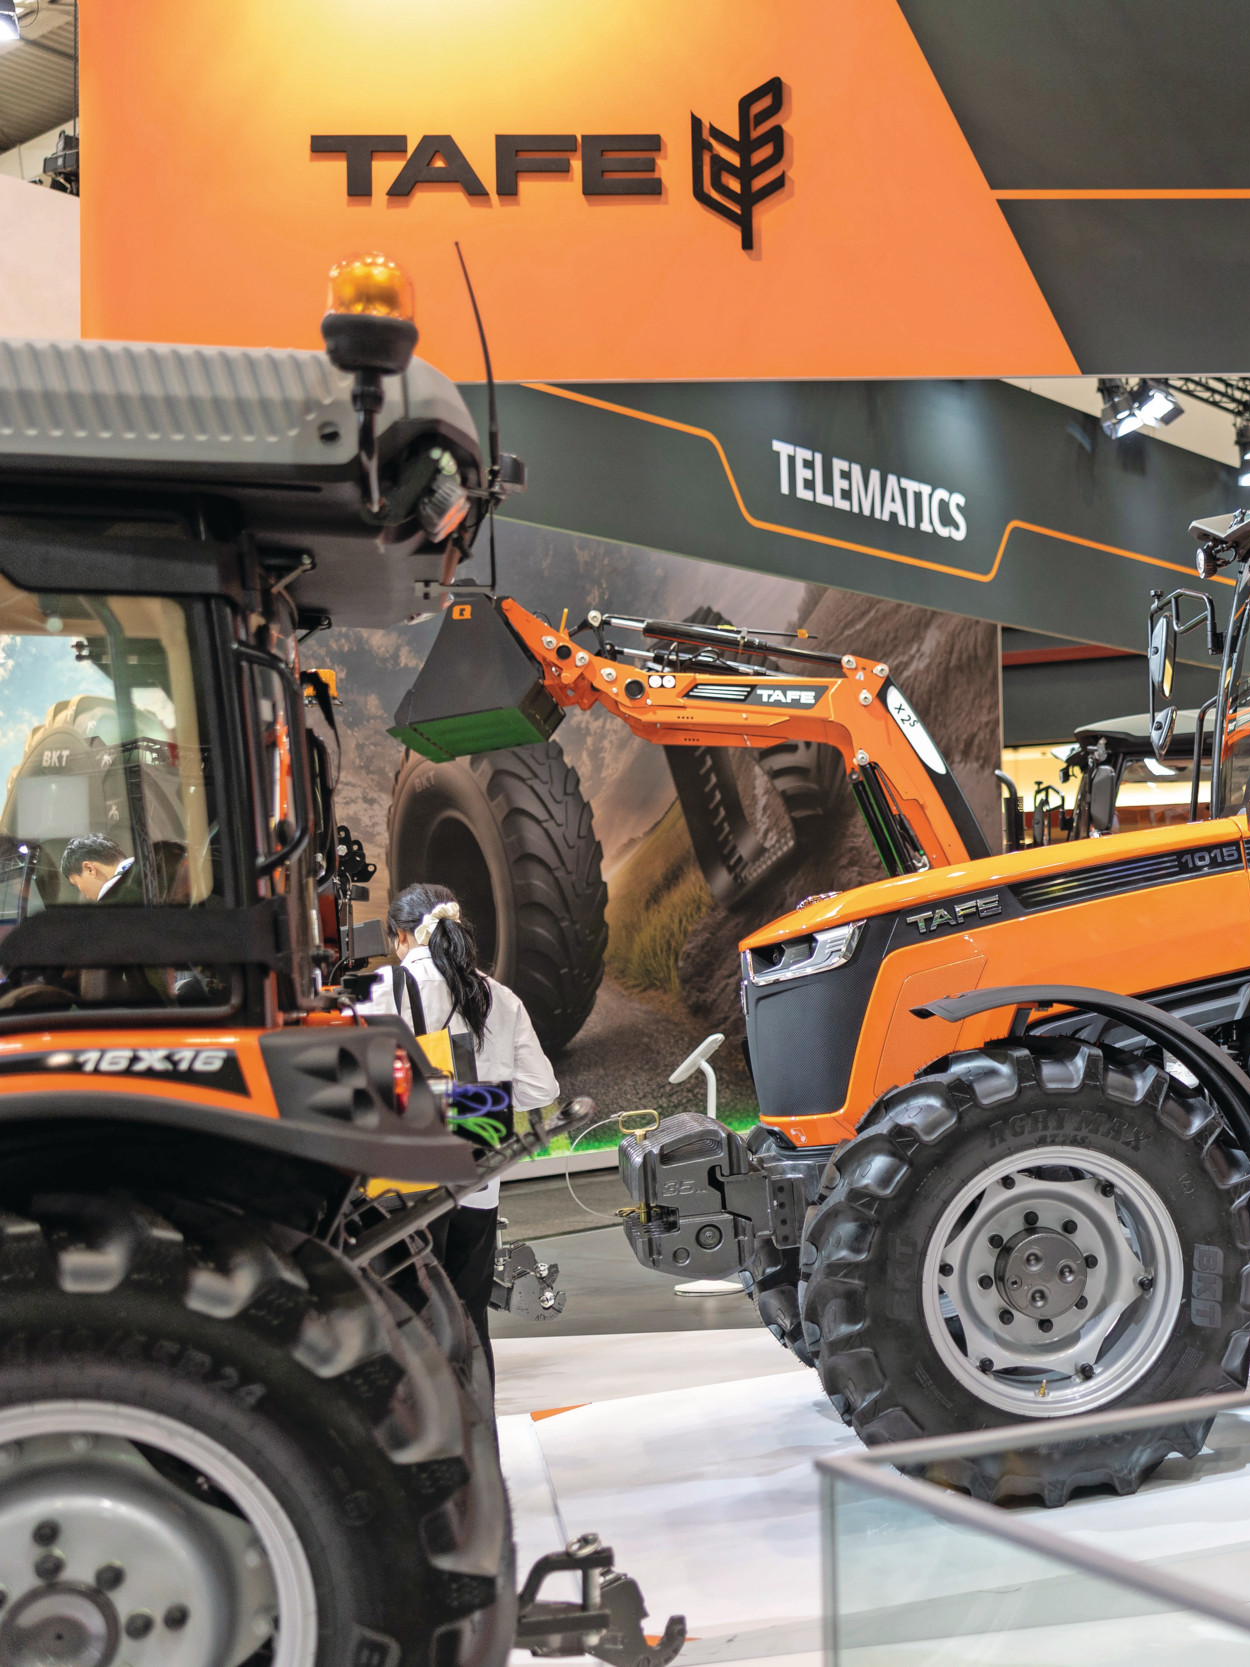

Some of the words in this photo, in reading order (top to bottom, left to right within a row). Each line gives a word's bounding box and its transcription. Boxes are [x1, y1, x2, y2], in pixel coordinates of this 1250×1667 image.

[310, 134, 663, 197] TAFE
[771, 439, 968, 542] TELEMATICS
[756, 689, 816, 704] TAFE
[42, 749, 70, 768] BKT
[1180, 846, 1238, 870] 1015
[905, 894, 1002, 935] TAFE
[76, 1049, 228, 1073] 16X16
[1191, 1243, 1224, 1329] BKT
